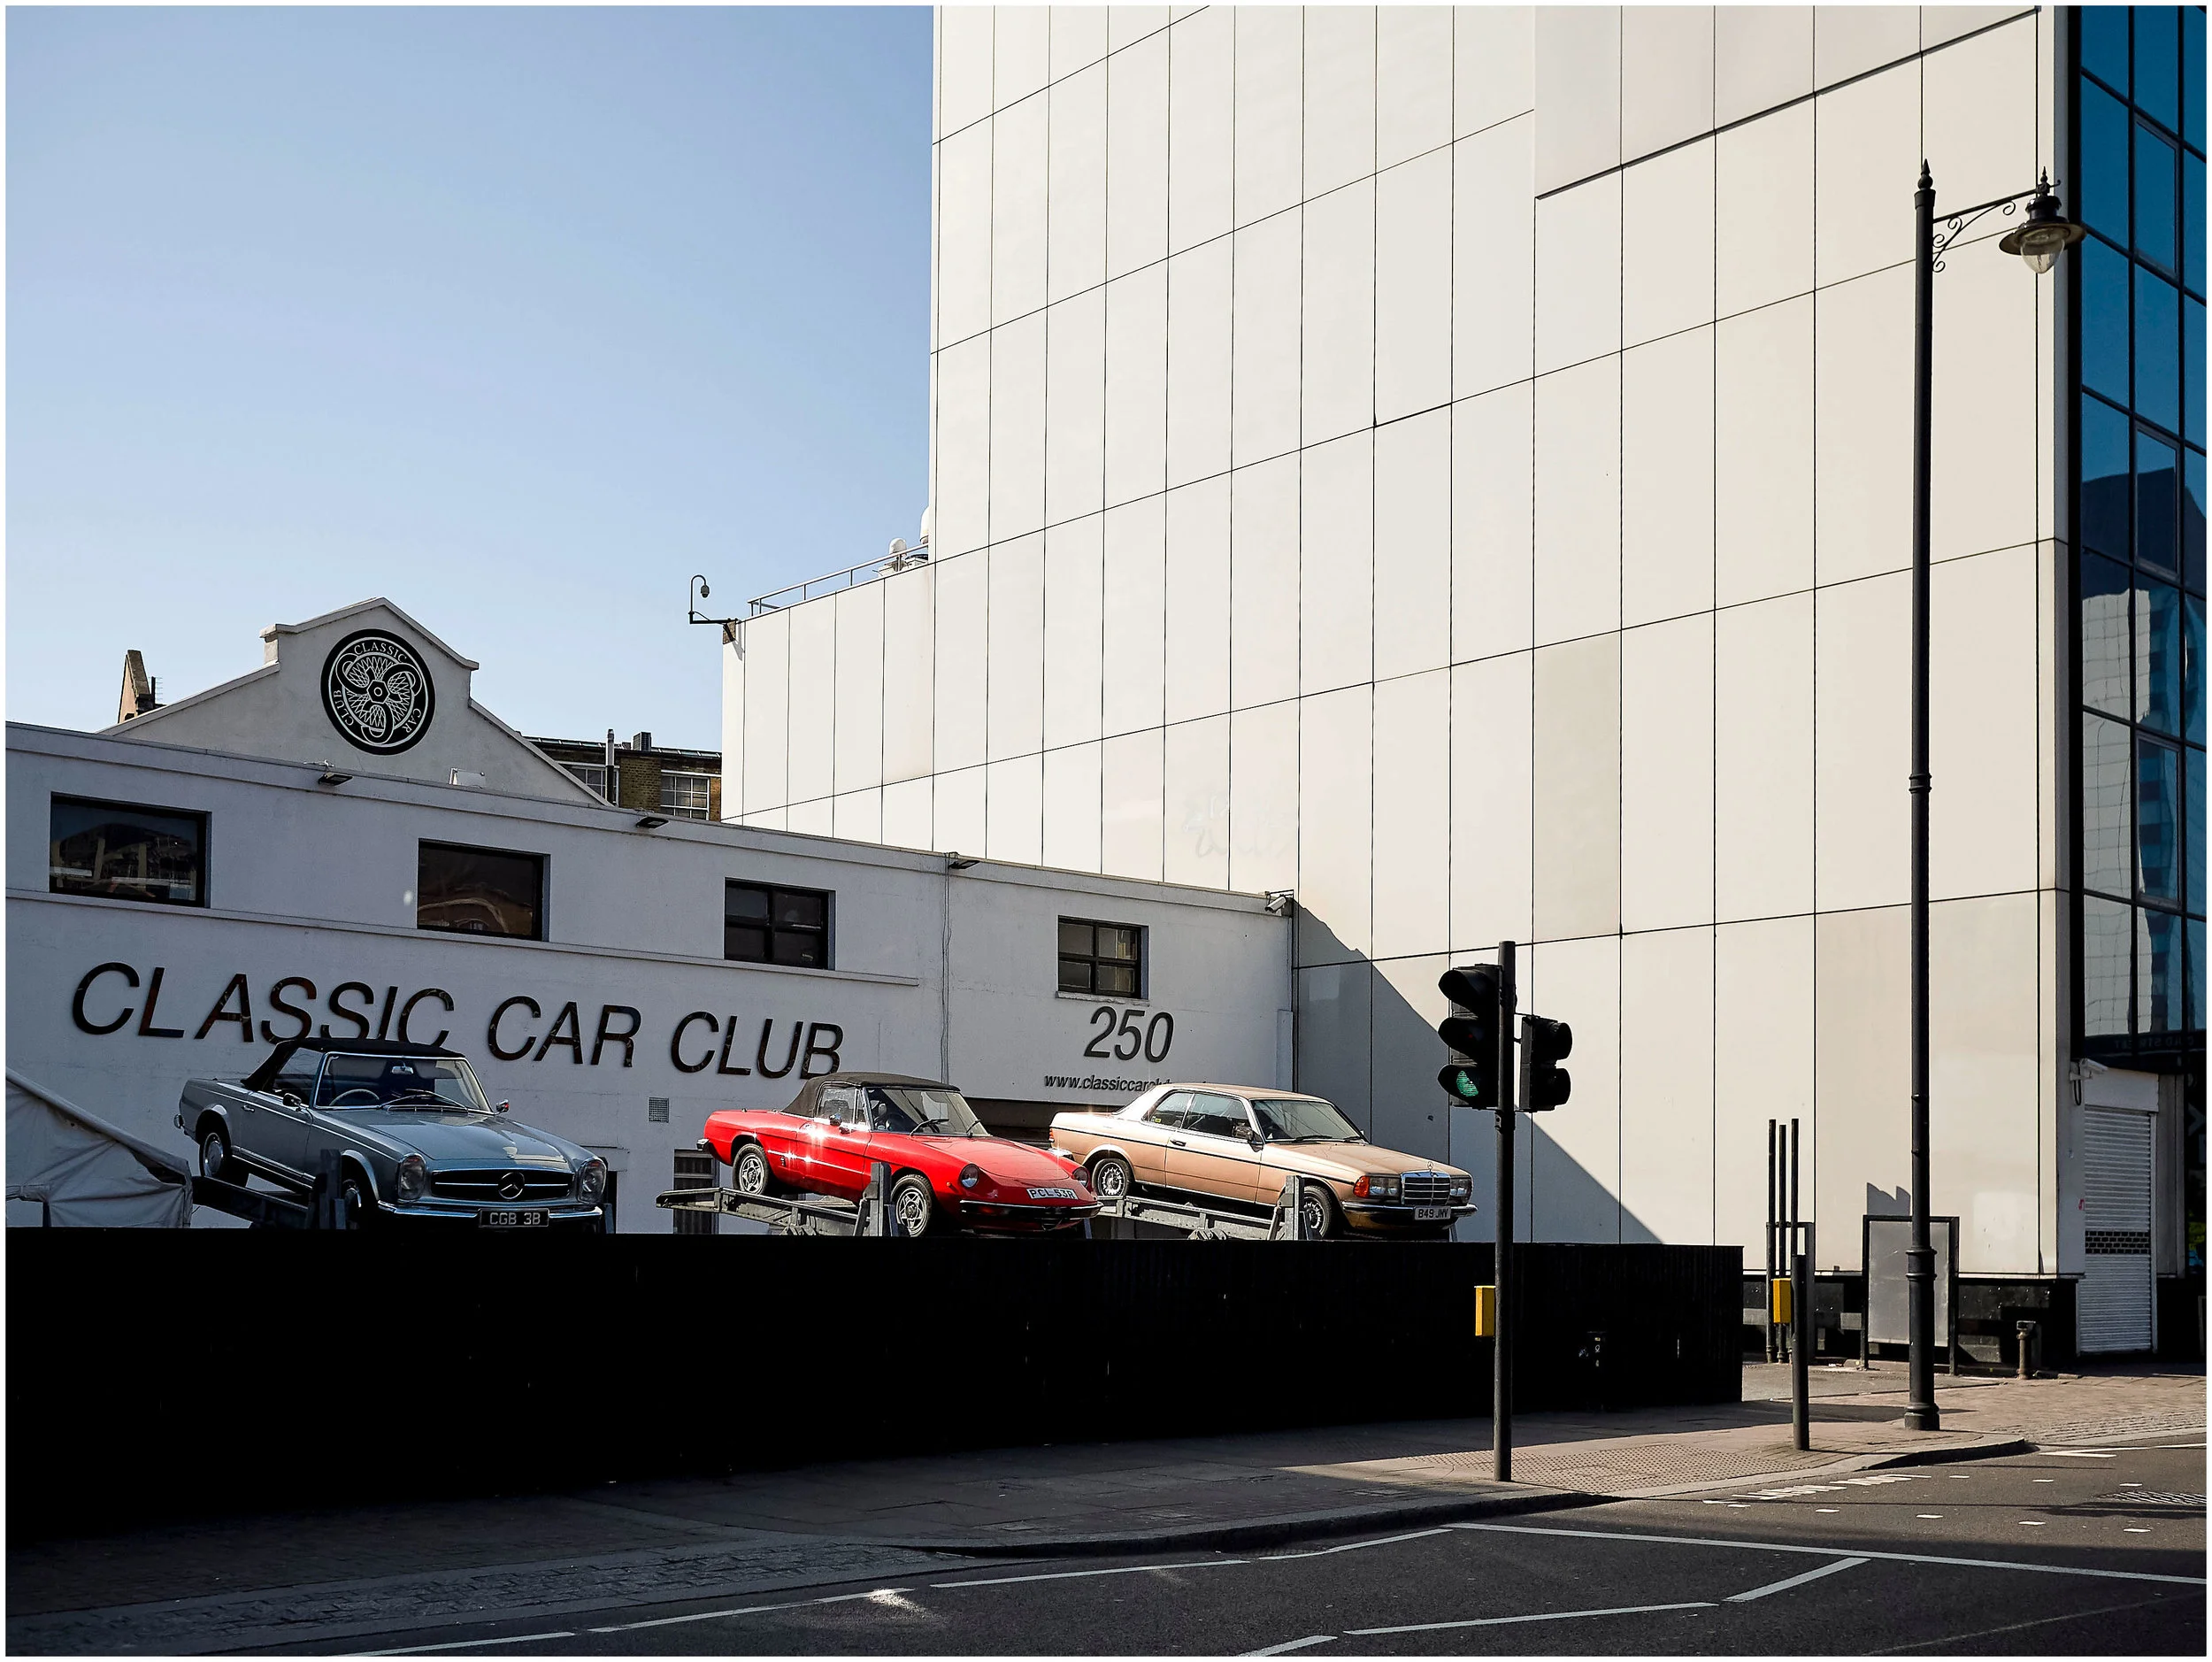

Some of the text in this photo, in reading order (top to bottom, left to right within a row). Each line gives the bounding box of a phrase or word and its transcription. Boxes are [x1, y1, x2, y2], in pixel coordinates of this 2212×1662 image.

[354, 642, 407, 663] CLASSIC
[333, 689, 354, 726] CLUB
[402, 708, 422, 734] CAR
[72, 961, 844, 1080] CLASSIC CAR CLUB
[1084, 1005, 1174, 1063] 250
[1029, 1189, 1075, 1199] PCL 53R
[489, 1212, 541, 1225] CGB 3B
[1417, 1208, 1434, 1219] B49
